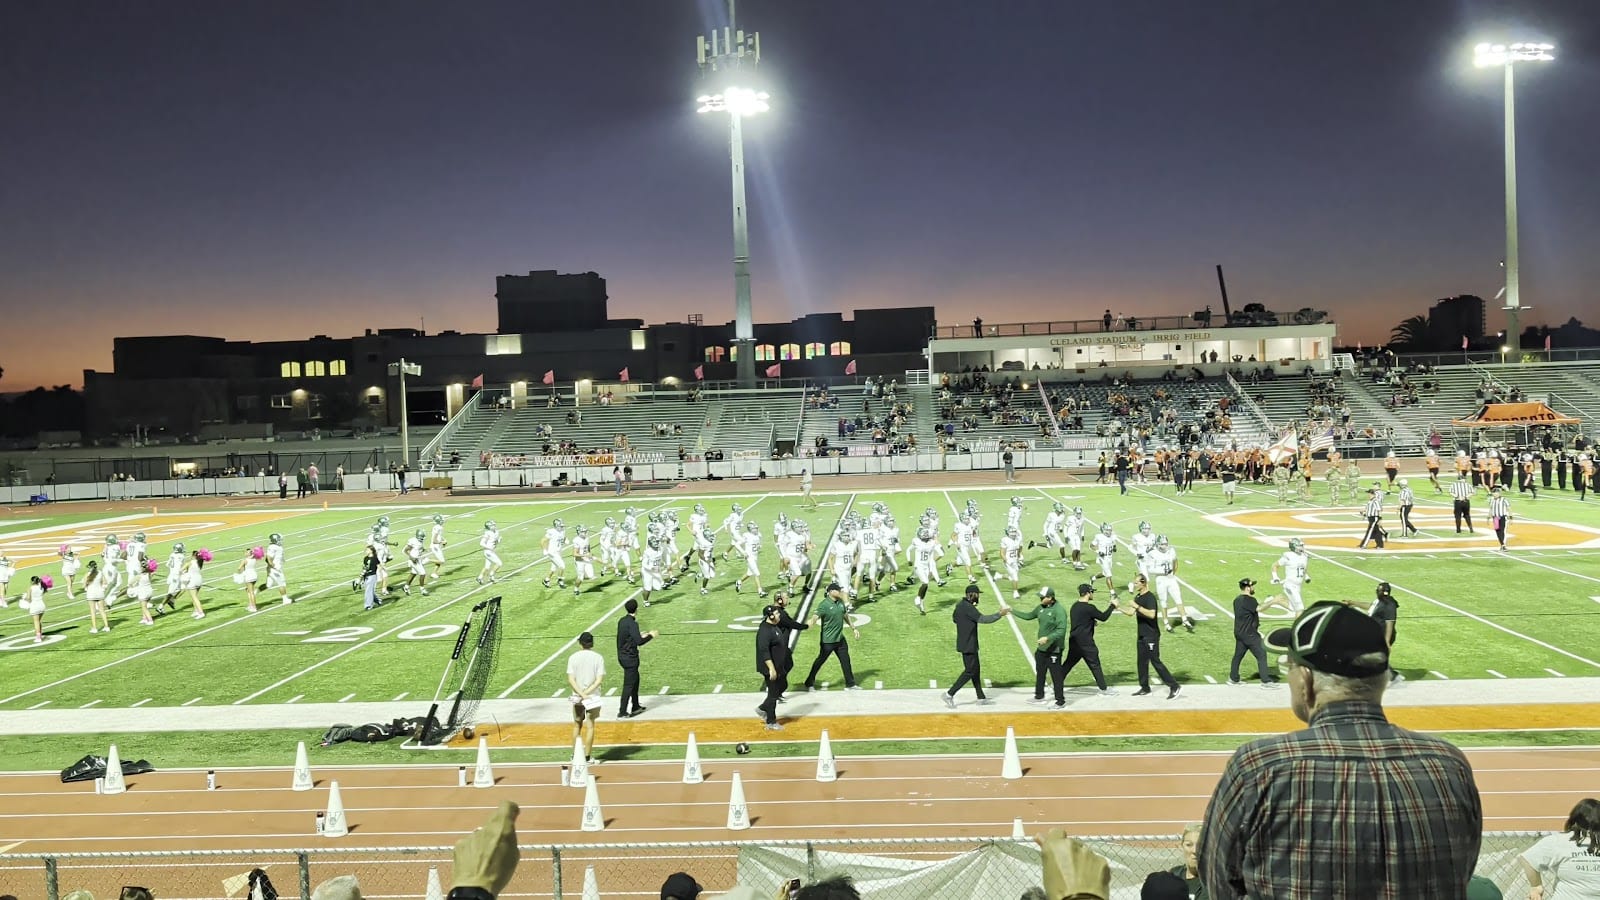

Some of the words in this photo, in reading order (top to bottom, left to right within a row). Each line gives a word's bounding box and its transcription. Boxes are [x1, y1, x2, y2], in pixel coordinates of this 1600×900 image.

[1096, 335, 1137, 344] STADIUM
[1184, 332, 1211, 341] FIELD
[863, 533, 874, 544] 88
[843, 554, 852, 564] 61
[920, 551, 929, 561] 16
